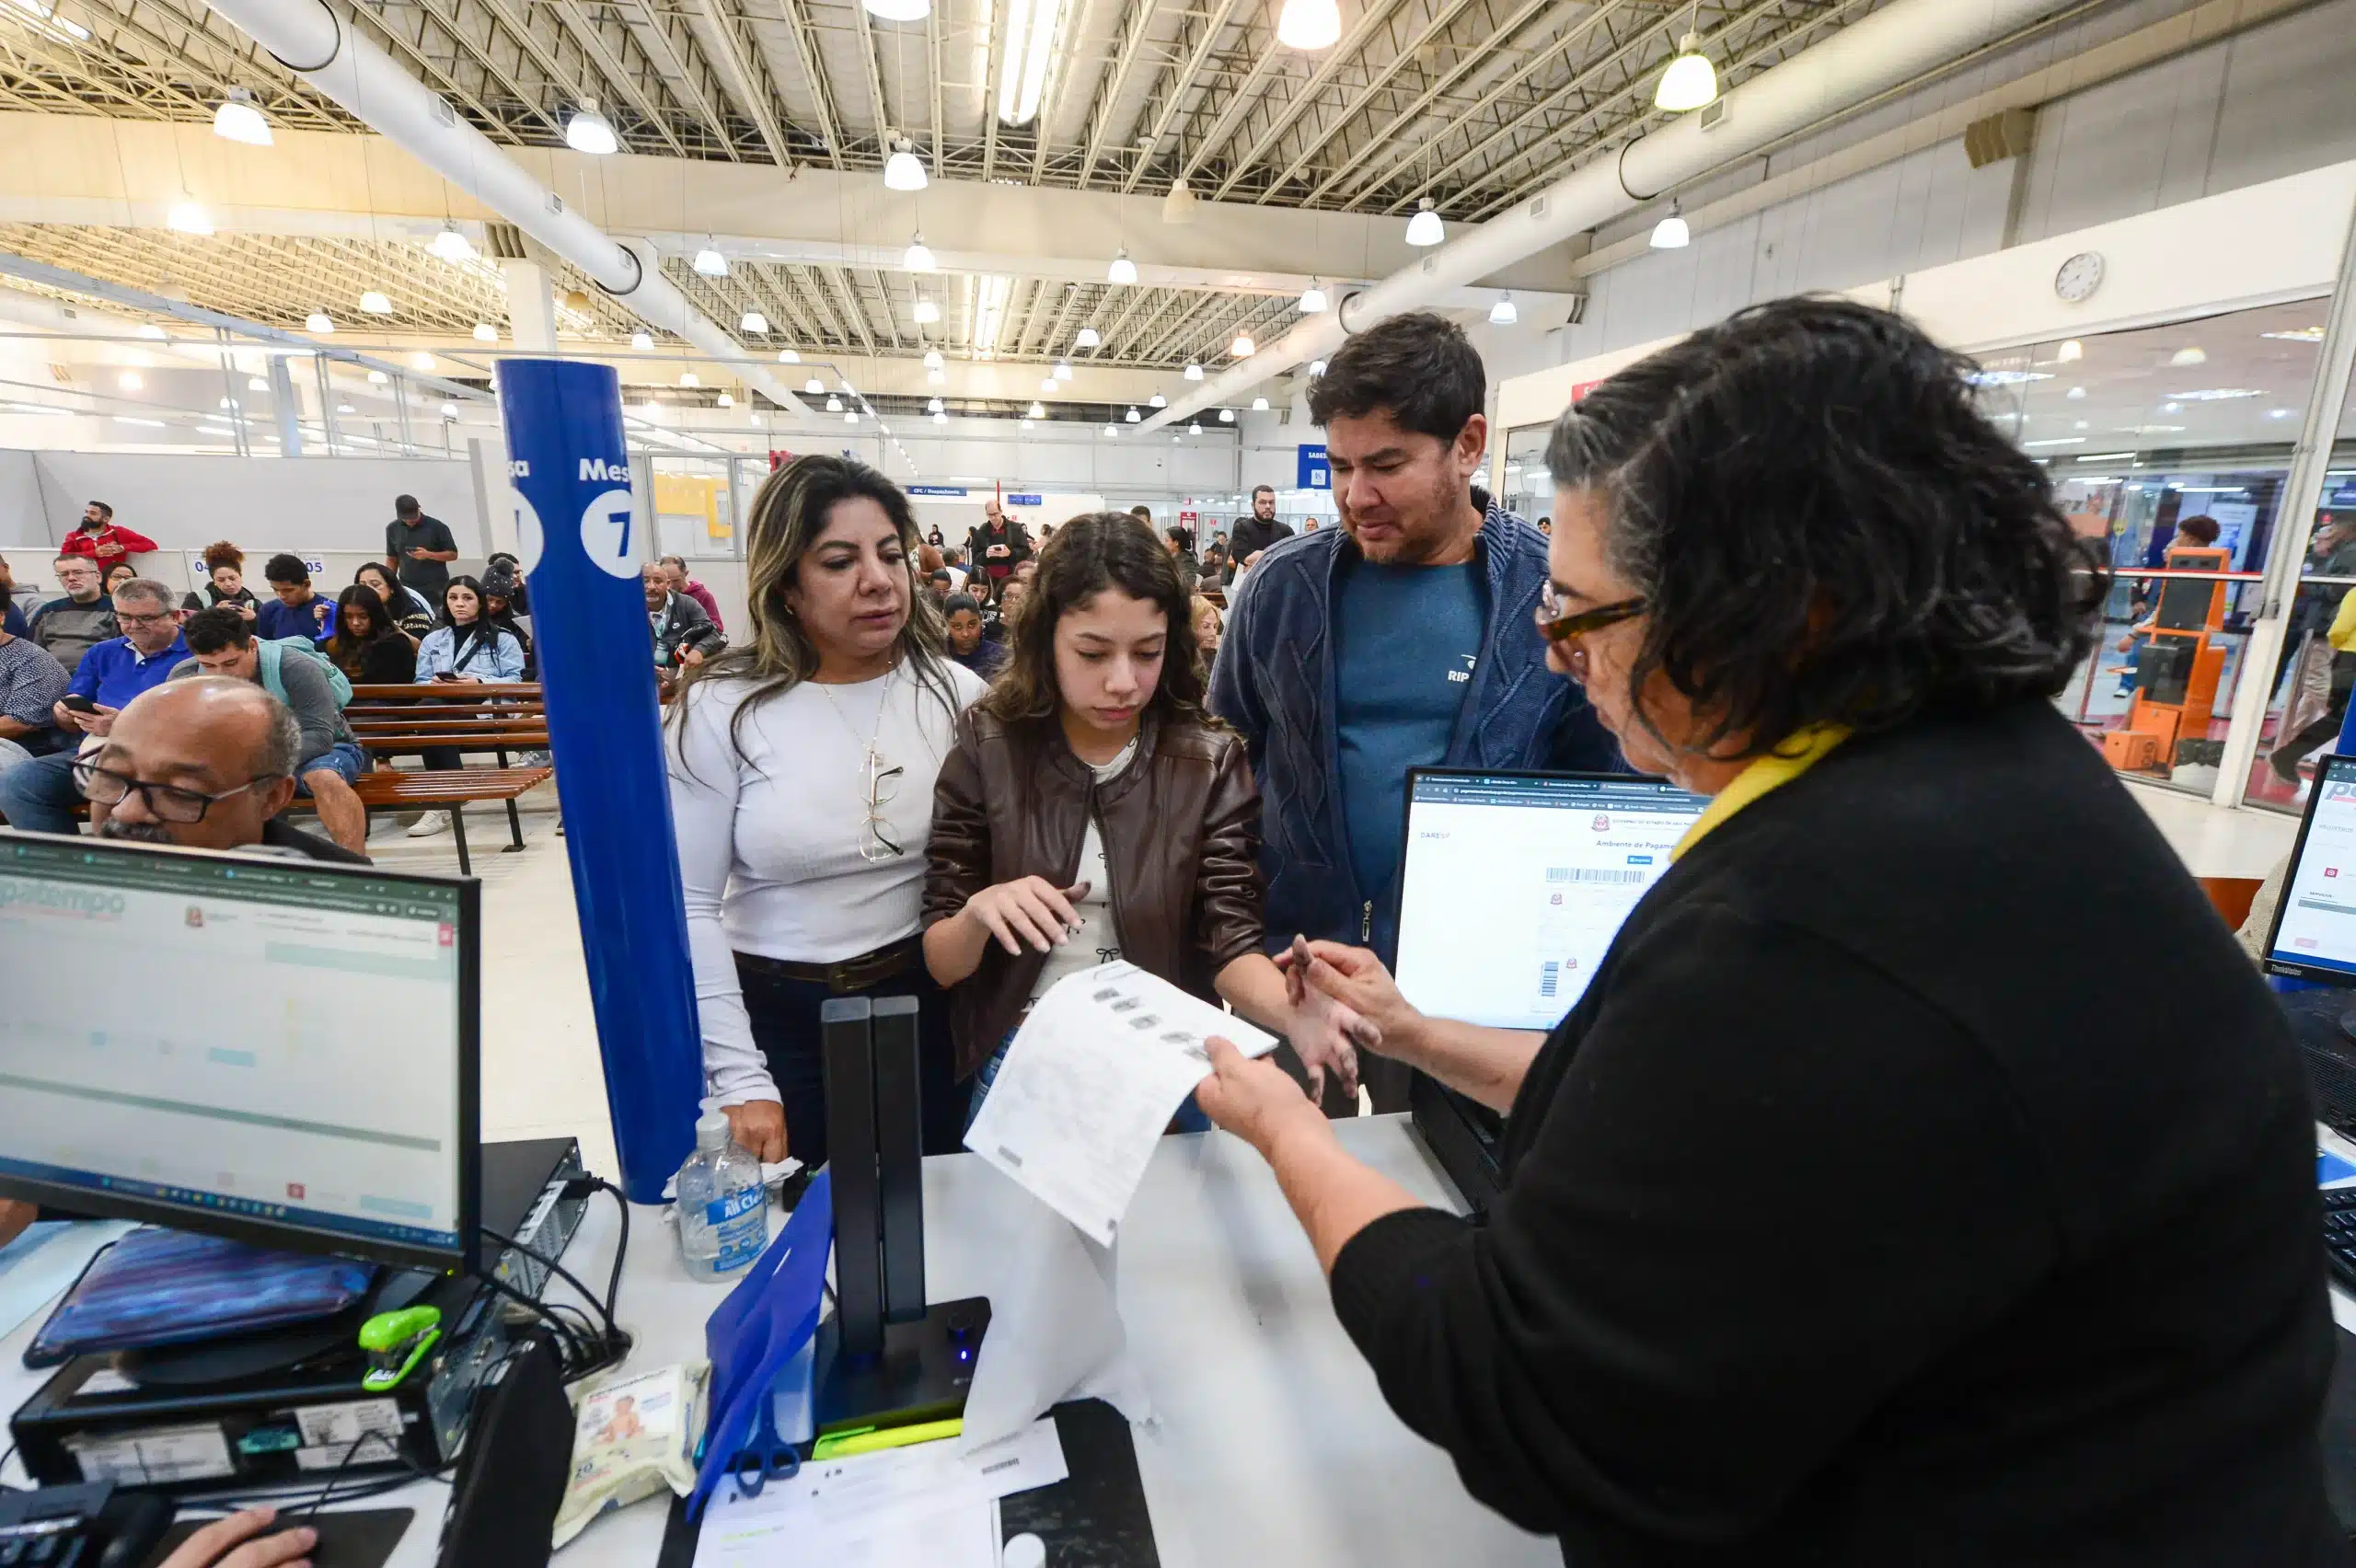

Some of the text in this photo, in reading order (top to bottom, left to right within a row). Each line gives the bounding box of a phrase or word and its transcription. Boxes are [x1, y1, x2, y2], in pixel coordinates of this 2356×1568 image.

[607, 511, 631, 558] 7
[1448, 670, 1470, 683] RIP
[1596, 840, 1634, 848] Ambiente
